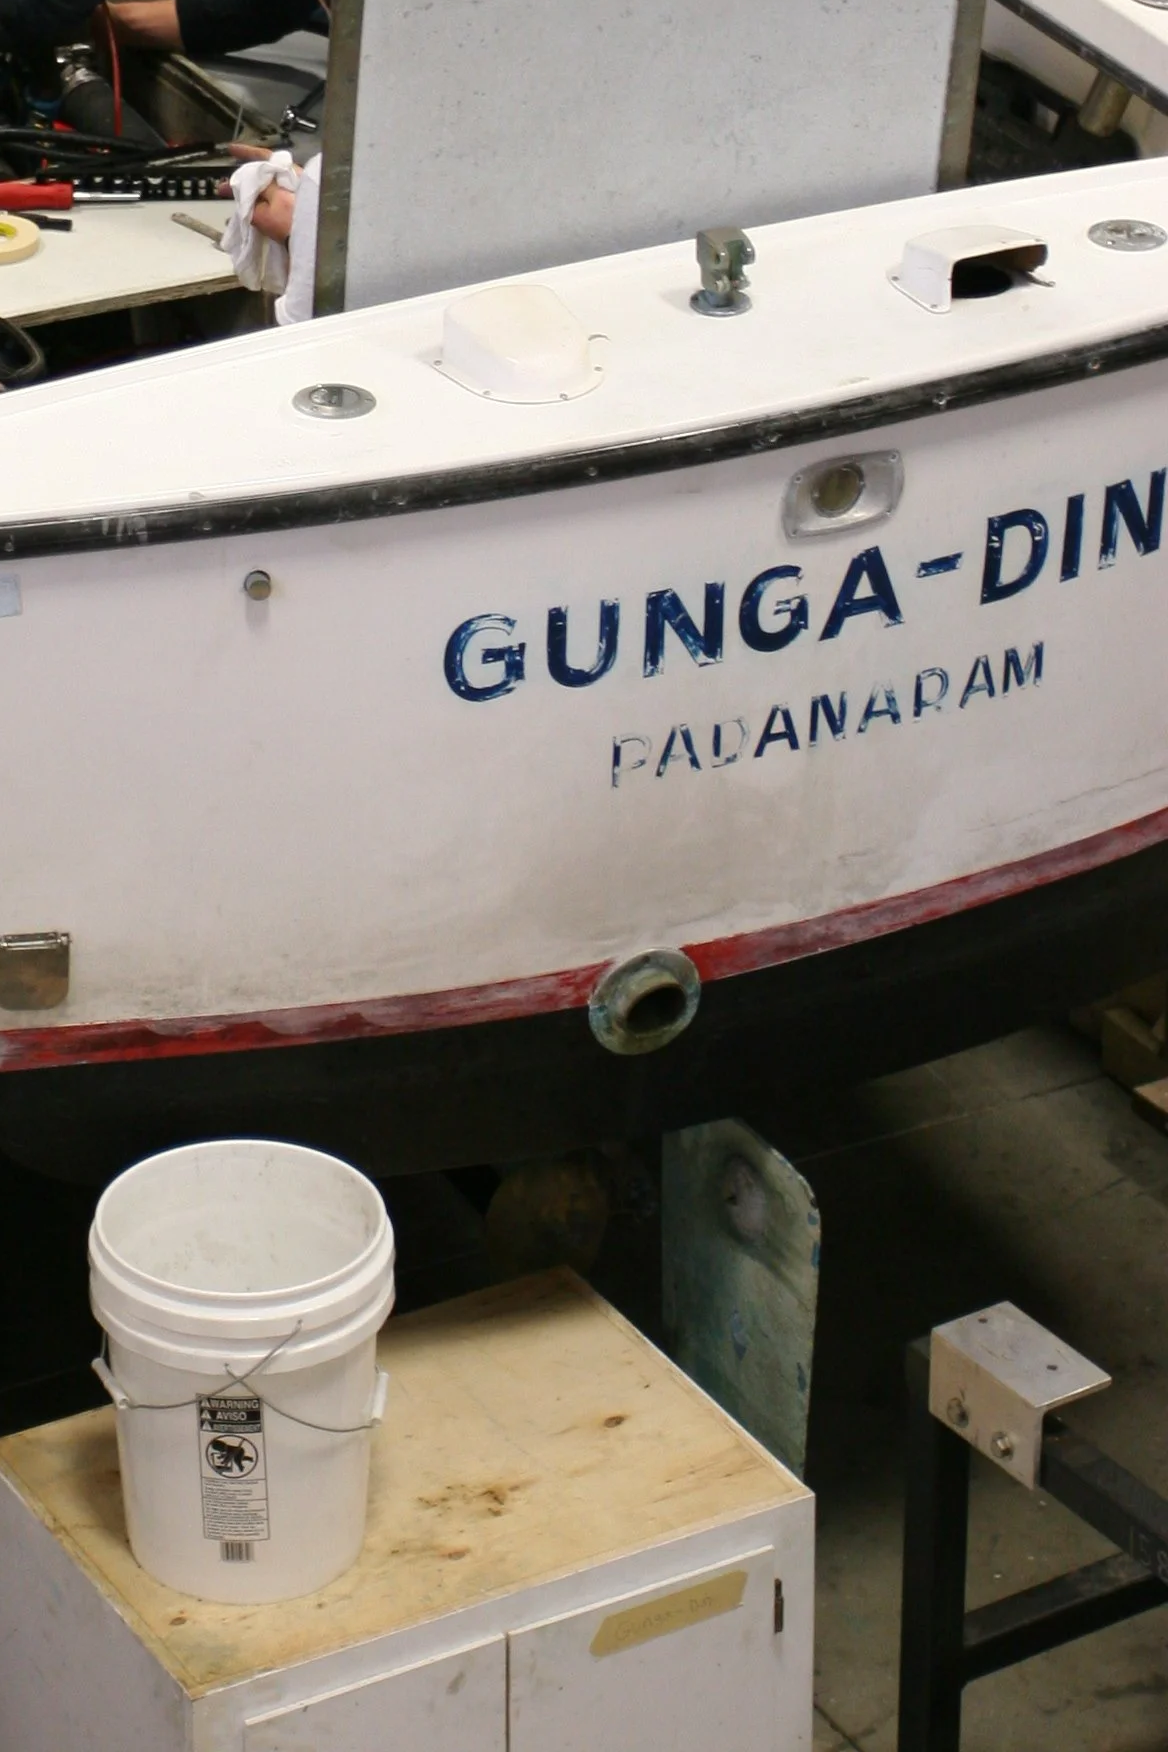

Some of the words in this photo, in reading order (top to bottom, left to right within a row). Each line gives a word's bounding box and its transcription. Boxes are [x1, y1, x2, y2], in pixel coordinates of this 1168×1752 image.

[443, 466, 1168, 703] GUNGA-DIN
[209, 1399, 259, 1409] WARNING
[215, 1411, 248, 1421] AVISO
